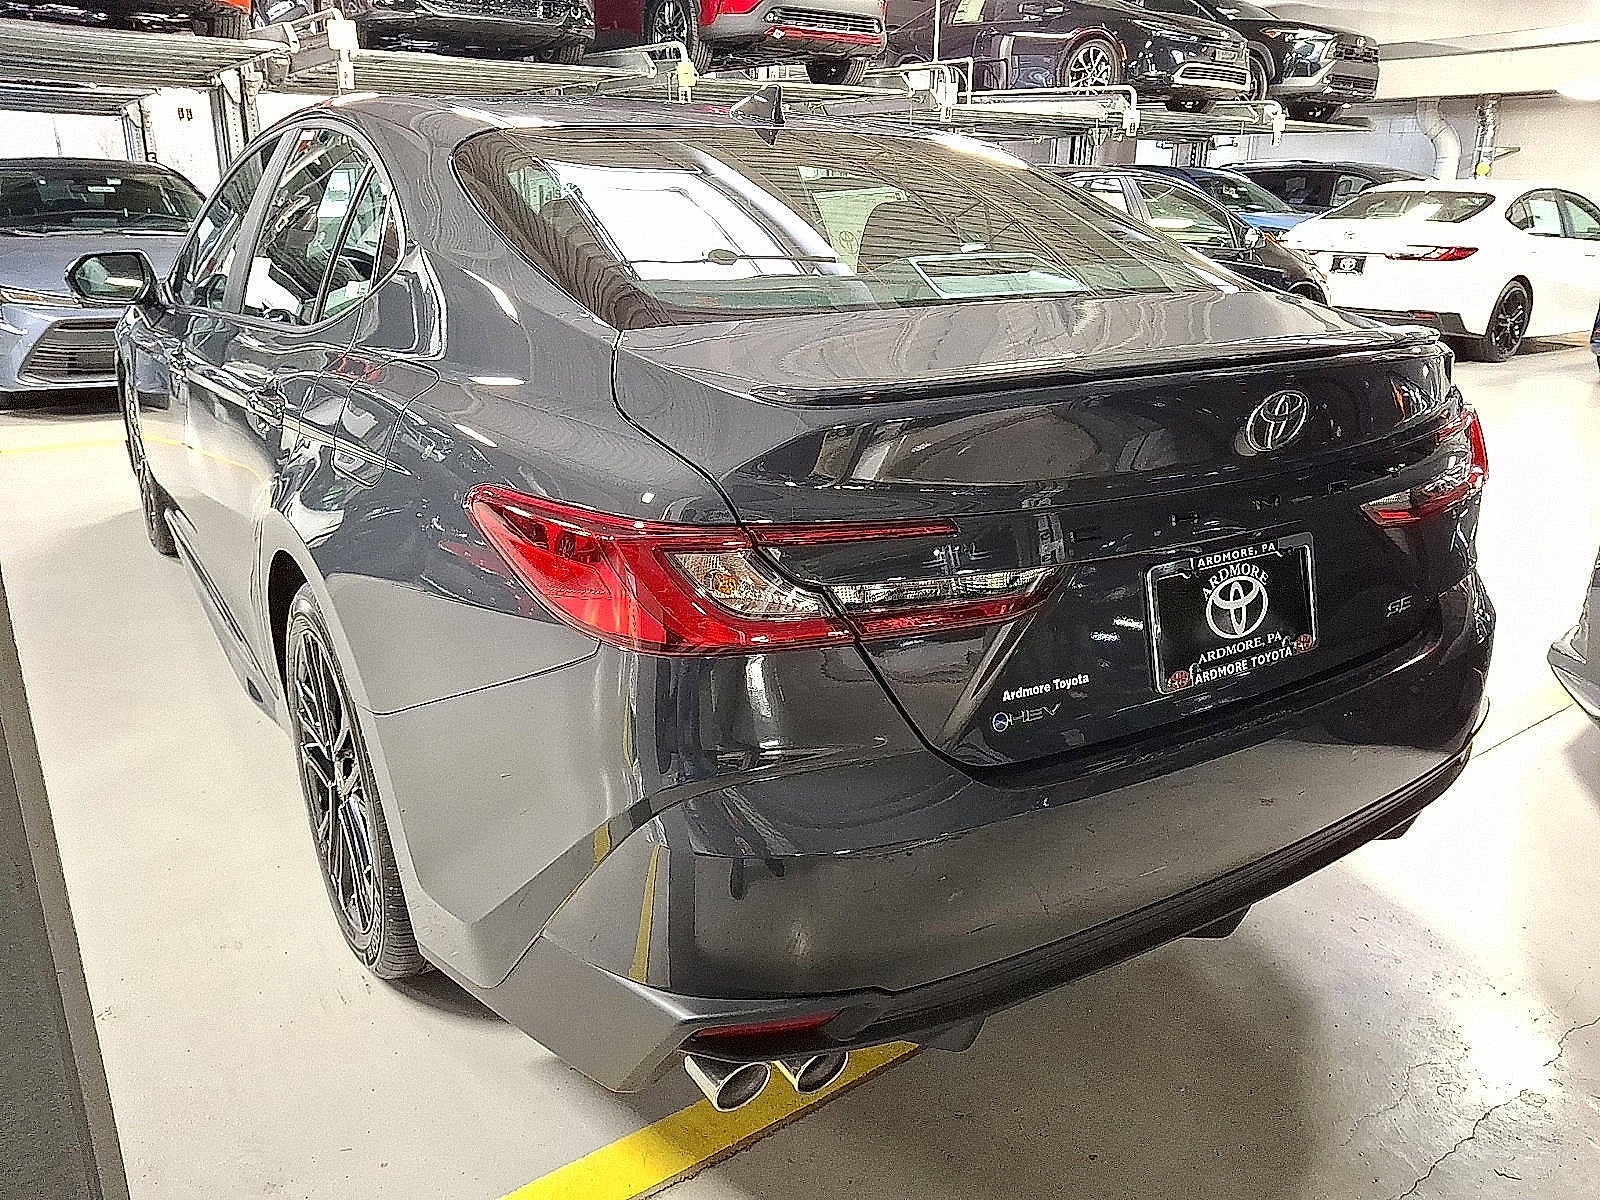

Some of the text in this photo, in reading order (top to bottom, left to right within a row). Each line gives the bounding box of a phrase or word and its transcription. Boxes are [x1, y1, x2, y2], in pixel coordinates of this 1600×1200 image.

[1198, 542, 1276, 568] ARDMORE, PA
[1202, 563, 1269, 600] ARDMORE
[1198, 631, 1283, 665] ARDMORE, PA
[1195, 646, 1293, 686] ARDMORE TOYOTA
[1002, 673, 1090, 702] Ardmore Toyota
[1008, 702, 1062, 726] HEV
